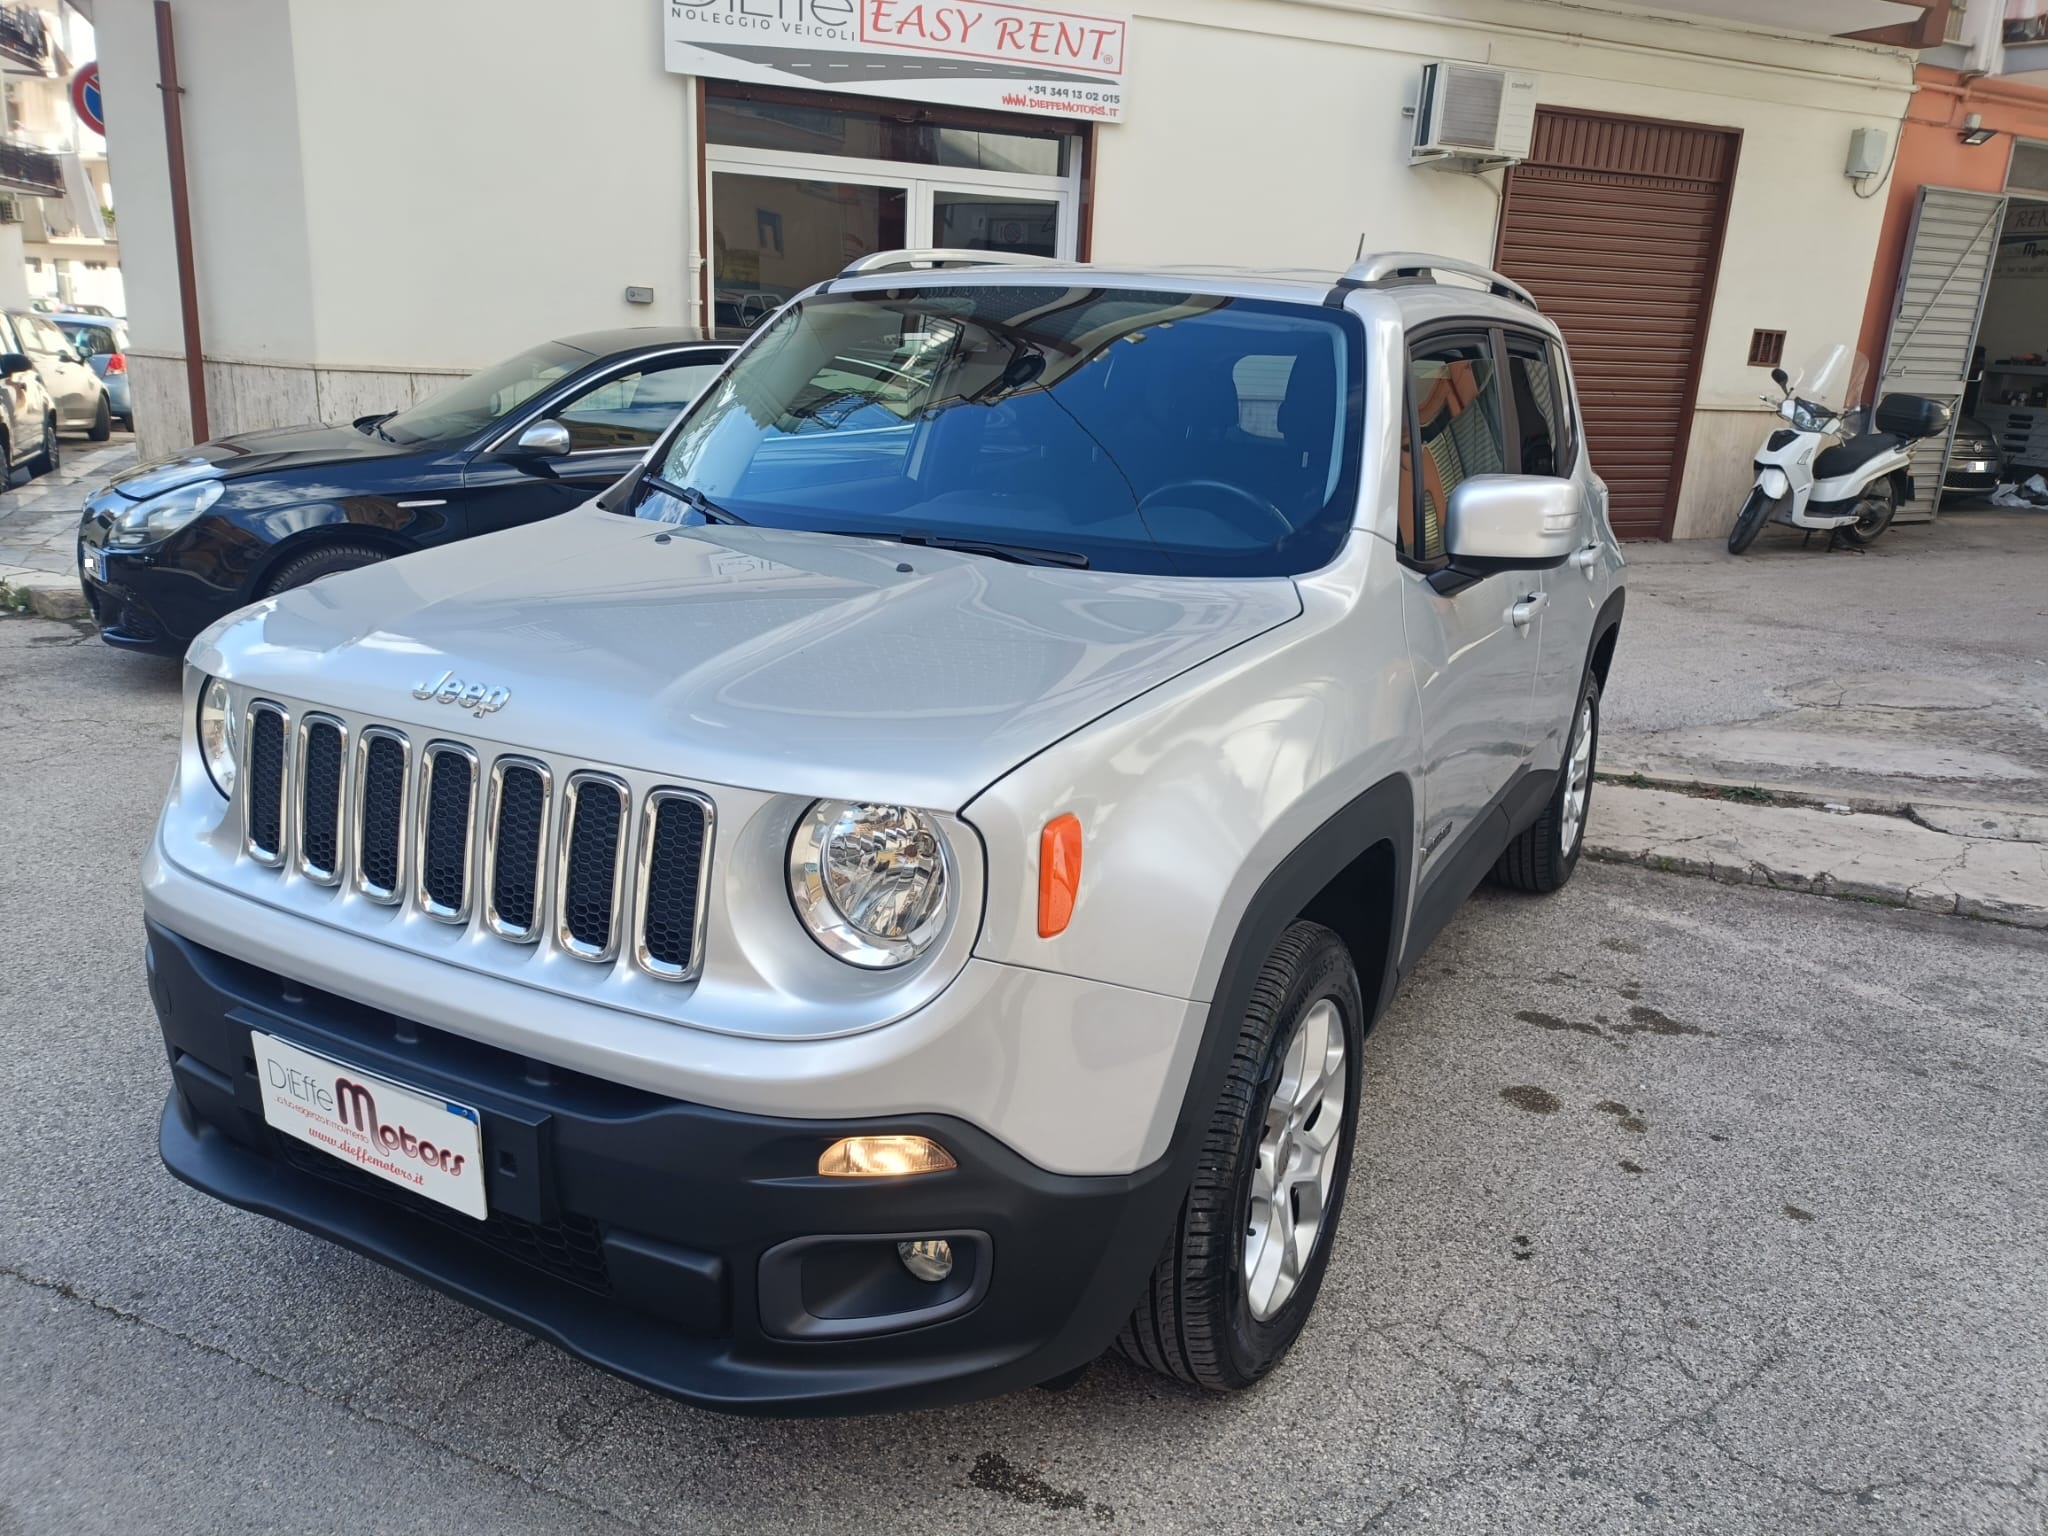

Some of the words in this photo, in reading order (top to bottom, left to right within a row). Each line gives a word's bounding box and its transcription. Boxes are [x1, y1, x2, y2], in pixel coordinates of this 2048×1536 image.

[671, 7, 771, 30] NOLEGGIO
[782, 22, 856, 41] VEICOLI
[870, 0, 983, 43] EASY
[994, 17, 1117, 60] RENT
[1027, 85, 1047, 95] +39
[1050, 87, 1069, 98] 349
[1072, 89, 1083, 99] 13
[1085, 92, 1099, 101] 02
[1102, 94, 1120, 103] 015
[412, 669, 512, 719] Jeep
[267, 1058, 334, 1112] DiEffe
[335, 1077, 465, 1177] Motors
[308, 1127, 425, 1186] www.dieffemotors.it
